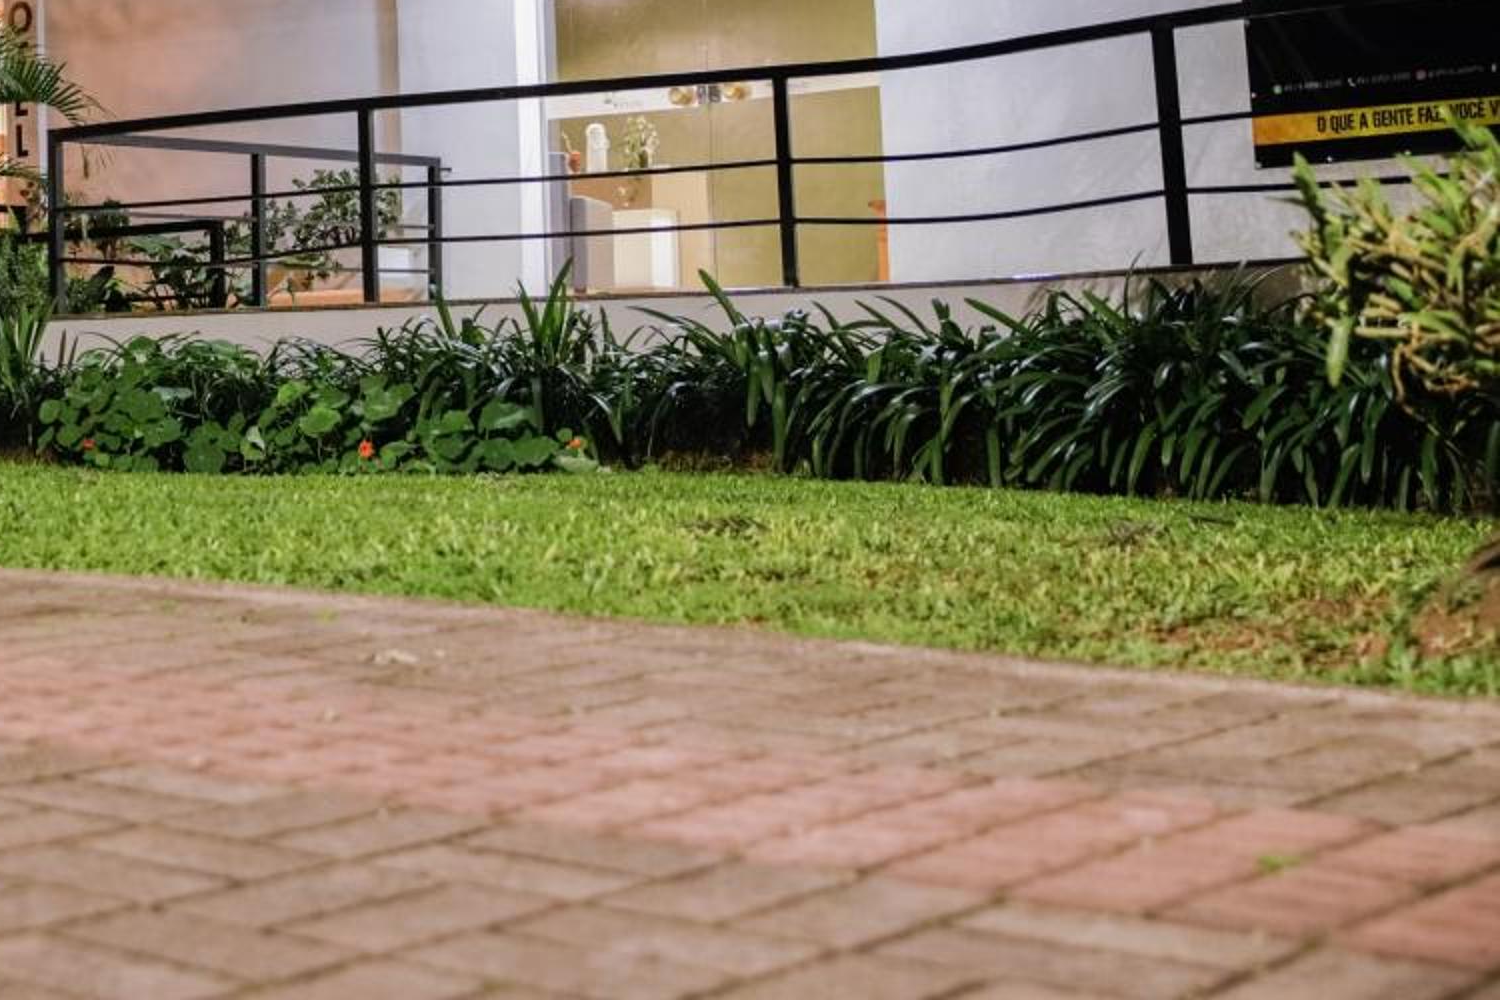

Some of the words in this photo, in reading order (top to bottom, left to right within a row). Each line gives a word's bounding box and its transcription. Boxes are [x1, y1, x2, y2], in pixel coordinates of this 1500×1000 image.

[1316, 116, 1327, 133] O
[1329, 113, 1354, 132] QUE
[1358, 112, 1370, 130] A
[1373, 108, 1414, 128] GENTE
